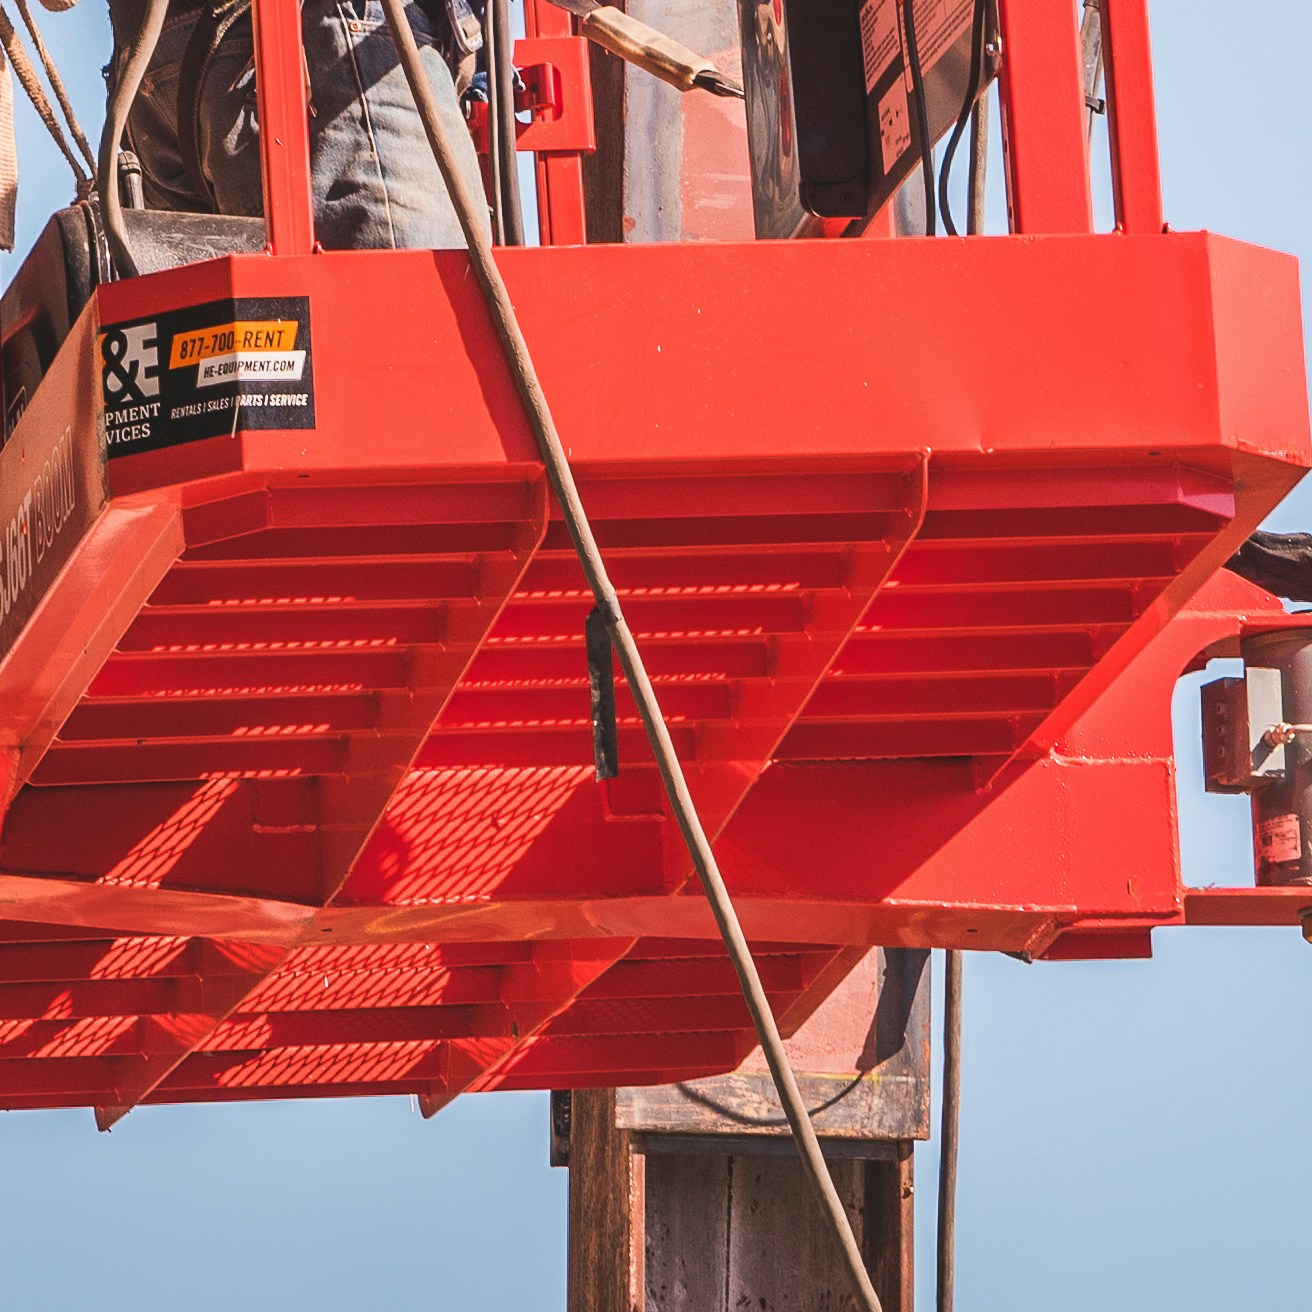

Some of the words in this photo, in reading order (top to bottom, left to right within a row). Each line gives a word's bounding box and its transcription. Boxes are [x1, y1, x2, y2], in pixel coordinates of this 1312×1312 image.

[179, 329, 285, 360] 877-700-RENT
[203, 360, 296, 379] HE-EQUIPMENT.COM
[170, 402, 202, 420] RENTALS
[207, 397, 230, 412] SALES
[235, 393, 264, 407] PARTS
[269, 393, 309, 407] SERVICE
[34, 424, 76, 565] BOOM
